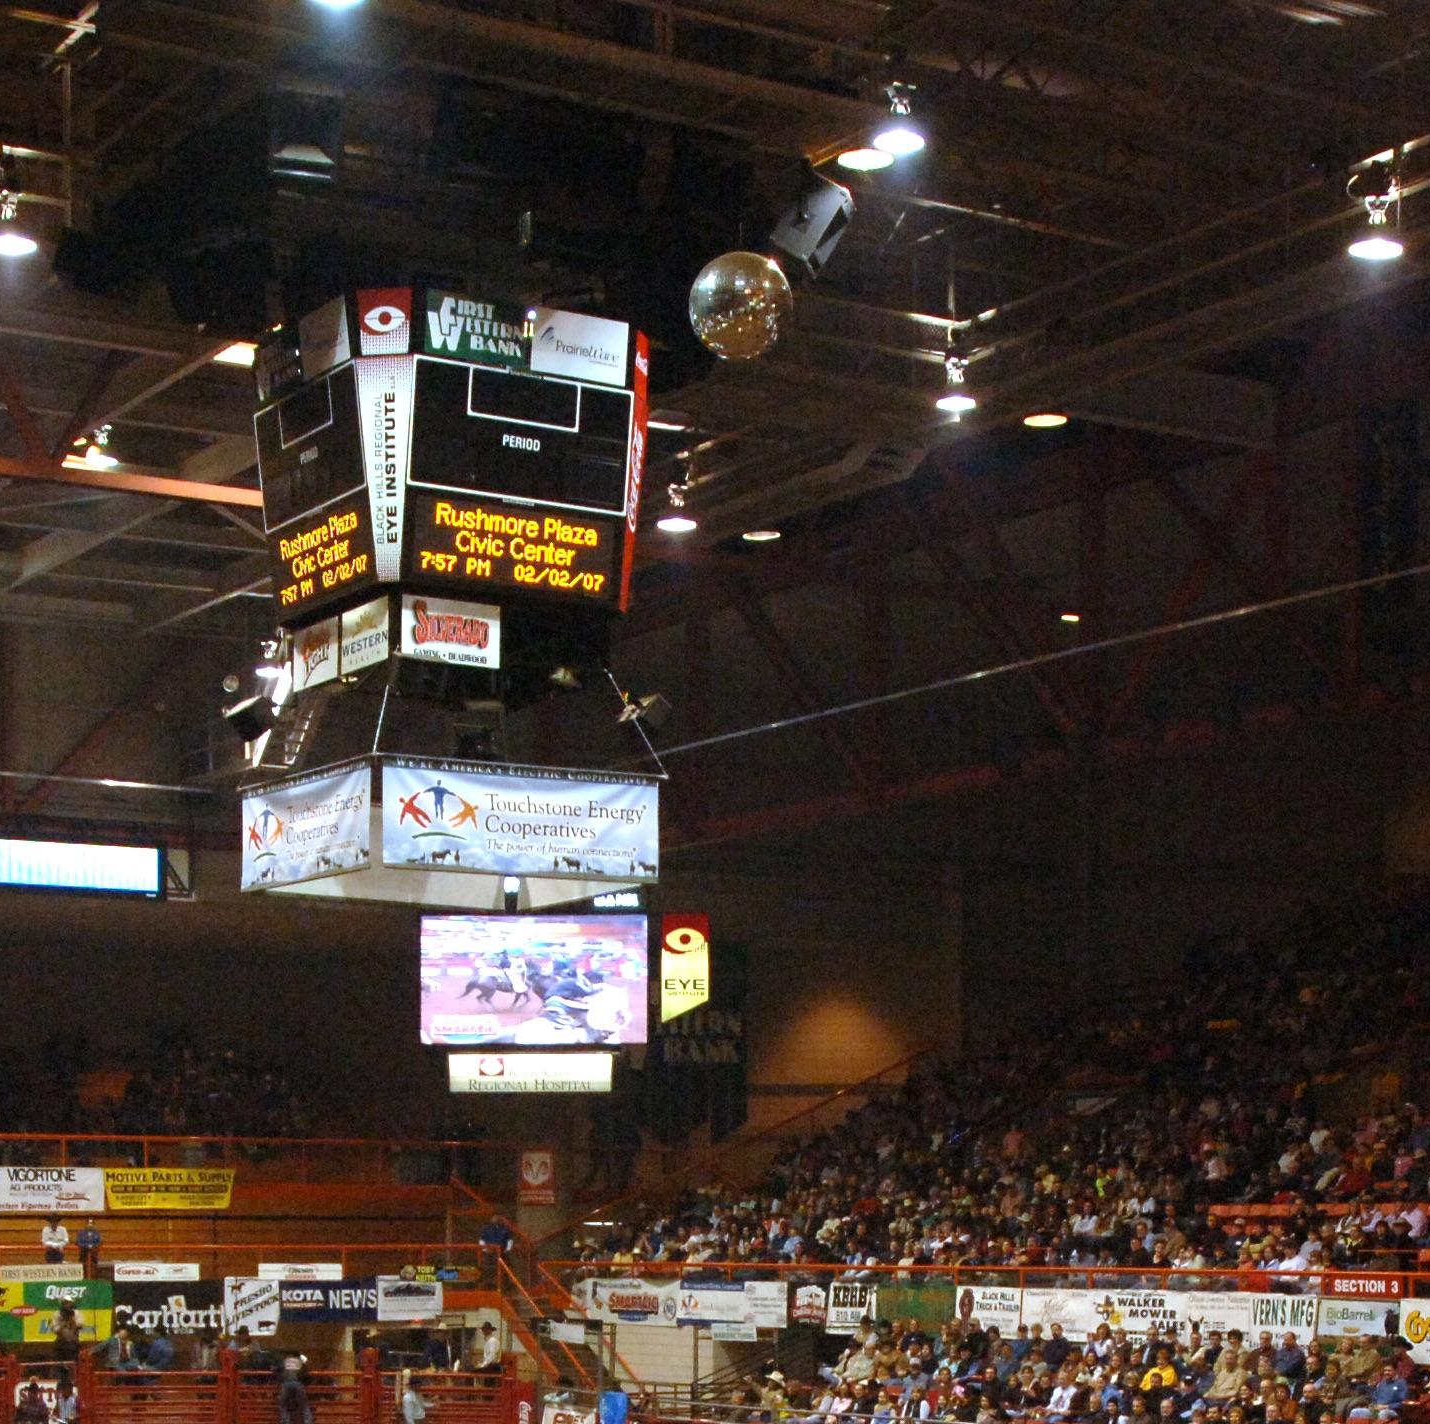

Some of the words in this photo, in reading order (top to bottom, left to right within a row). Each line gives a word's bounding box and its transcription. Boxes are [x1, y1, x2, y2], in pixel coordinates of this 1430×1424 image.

[440, 296, 494, 335] FIRST
[469, 336, 522, 357] BANK
[373, 392, 383, 457] REGIONAL
[384, 391, 397, 498] INSTITUTE
[502, 433, 541, 452] PERIOD
[375, 462, 383, 499] HILLS
[279, 523, 329, 560] Rushmore
[329, 511, 357, 539] Plaza
[377, 507, 385, 545] BLACK
[386, 505, 398, 545] EYE
[435, 502, 538, 539] Rushmore
[543, 517, 598, 546] Plaza
[292, 554, 315, 579] Civic
[317, 539, 349, 567] Center
[455, 531, 503, 557] Civic
[510, 538, 575, 567] Center
[301, 579, 313, 596] PM
[322, 555, 367, 588] 02/02/07
[421, 551, 457, 572] 7:57
[466, 558, 491, 577] PM
[513, 565, 604, 591] 02/02/07
[413, 599, 489, 648] SILVERADO
[342, 630, 388, 657] WESTERN
[485, 793, 582, 817] Touchstone
[286, 821, 339, 847] Cooperatives
[485, 815, 596, 839] Cooperatives
[487, 838, 504, 850] The
[506, 844, 533, 854] power
[536, 843, 546, 853] of
[548, 844, 580, 855] human
[664, 978, 705, 991] EYE
[7, 1169, 75, 1182] VIGORTONE
[106, 1172, 148, 1182] MOTIVE
[153, 1172, 183, 1182] PARTS
[187, 1173, 194, 1182] &
[832, 1286, 867, 1307] KBHB
[1001, 1293, 1015, 1301] HILLS
[1334, 1279, 1386, 1293] SECTION
[1391, 1281, 1399, 1293] 3
[282, 1290, 323, 1301] KOTA
[329, 1289, 377, 1310] NEWS
[1117, 1297, 1165, 1308] WALKER
[1128, 1309, 1177, 1319] MOWER
[1151, 1320, 1185, 1331] SALES
[1252, 1299, 1287, 1327] VERN'S
[1290, 1299, 1314, 1328] MFG
[1326, 1307, 1375, 1321] BioBarrel
